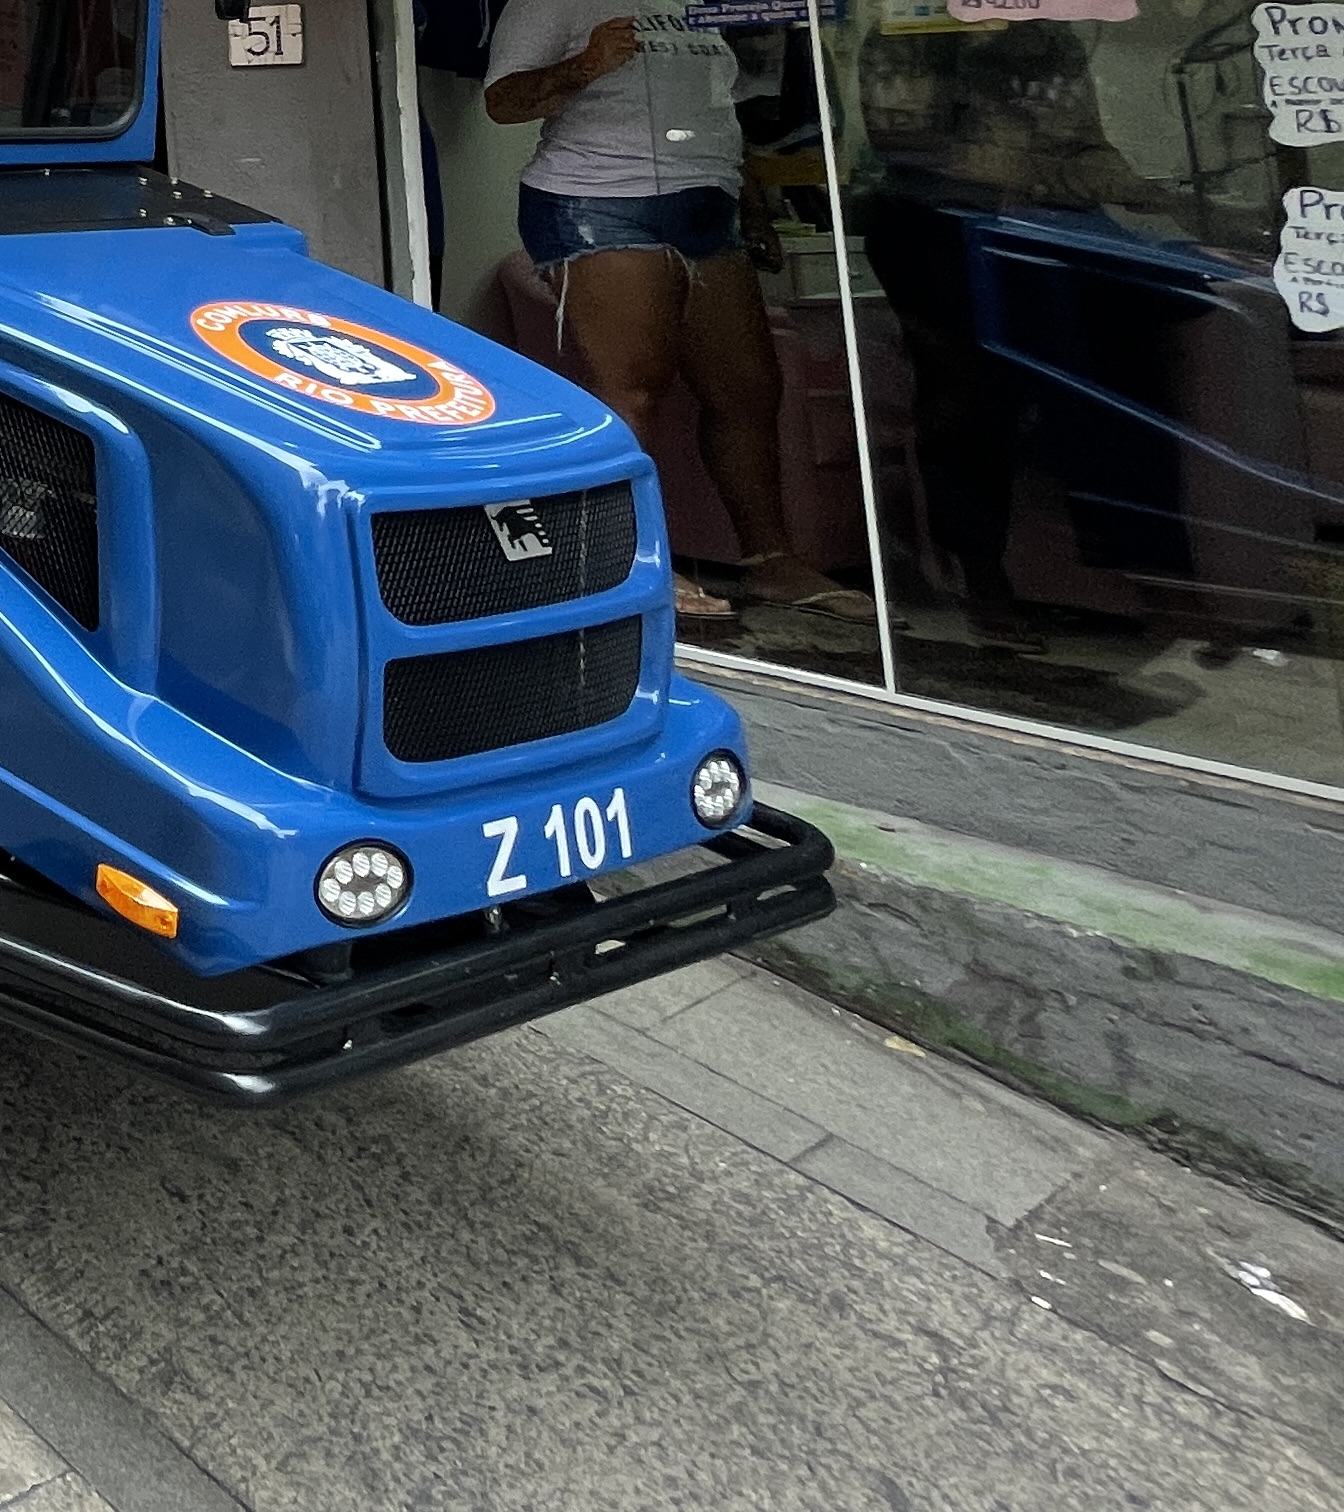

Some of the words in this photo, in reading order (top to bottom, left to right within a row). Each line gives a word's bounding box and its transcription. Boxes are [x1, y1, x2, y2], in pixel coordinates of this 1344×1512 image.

[246, 16, 284, 56] 51
[1295, 109, 1341, 133] R$
[196, 304, 331, 332] COMLURB
[274, 372, 355, 406] RIO
[370, 361, 488, 422] PREFEITURA
[482, 815, 527, 897] Z
[544, 787, 632, 878] 101
